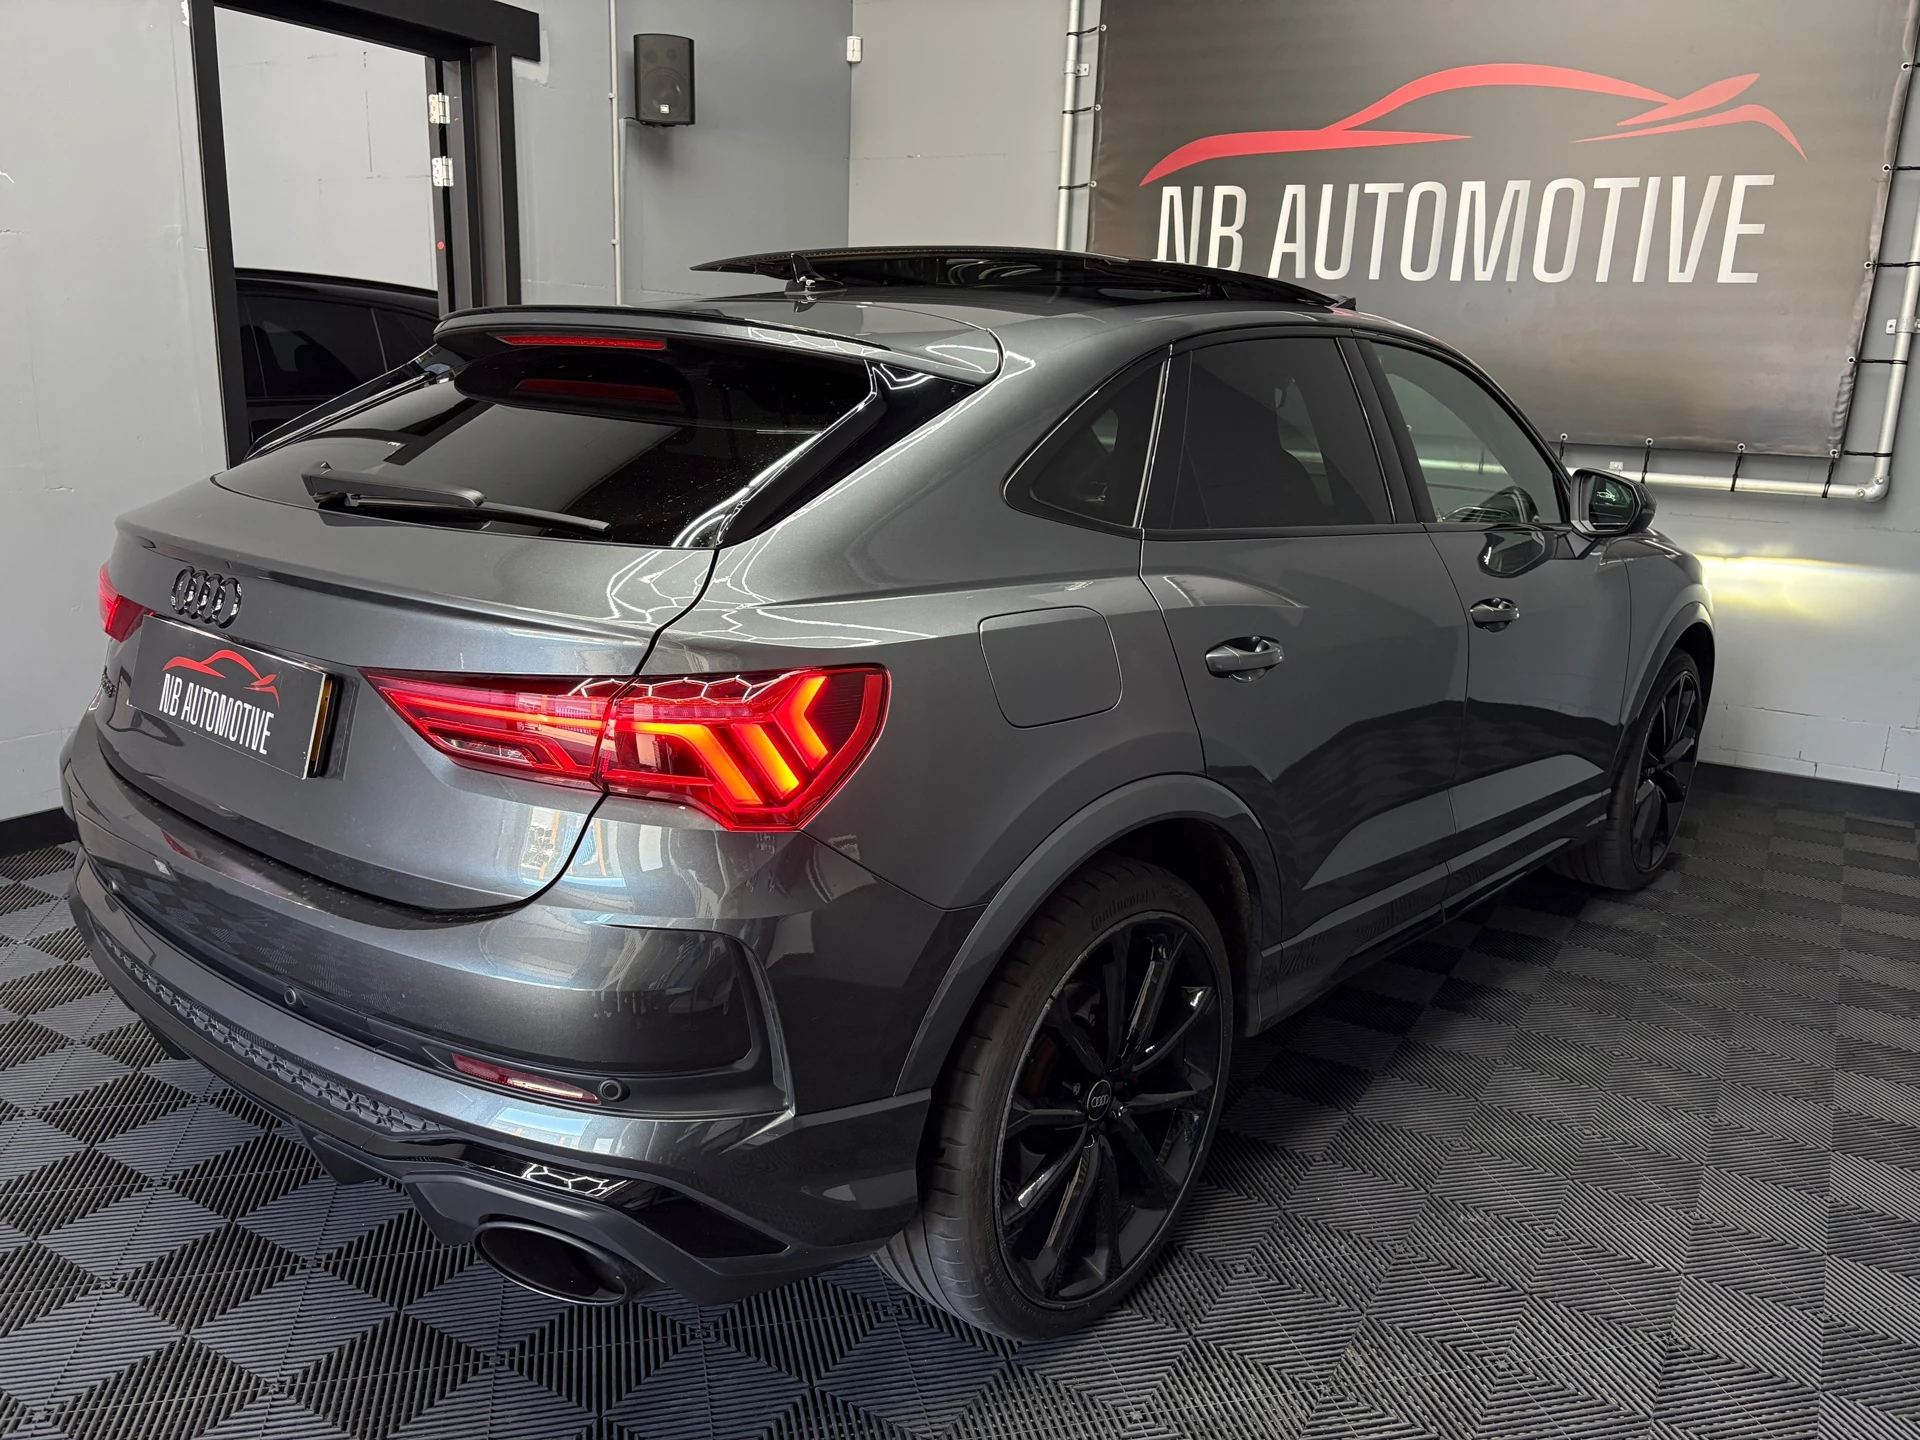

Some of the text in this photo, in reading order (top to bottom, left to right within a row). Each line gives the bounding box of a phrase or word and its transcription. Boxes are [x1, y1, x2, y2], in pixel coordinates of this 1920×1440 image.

[1156, 174, 1776, 284] NB AUTOMOTIVE
[158, 673, 183, 717] NB
[180, 681, 275, 755] AUTOMOTIVE
[1090, 887, 1149, 932] Continental
